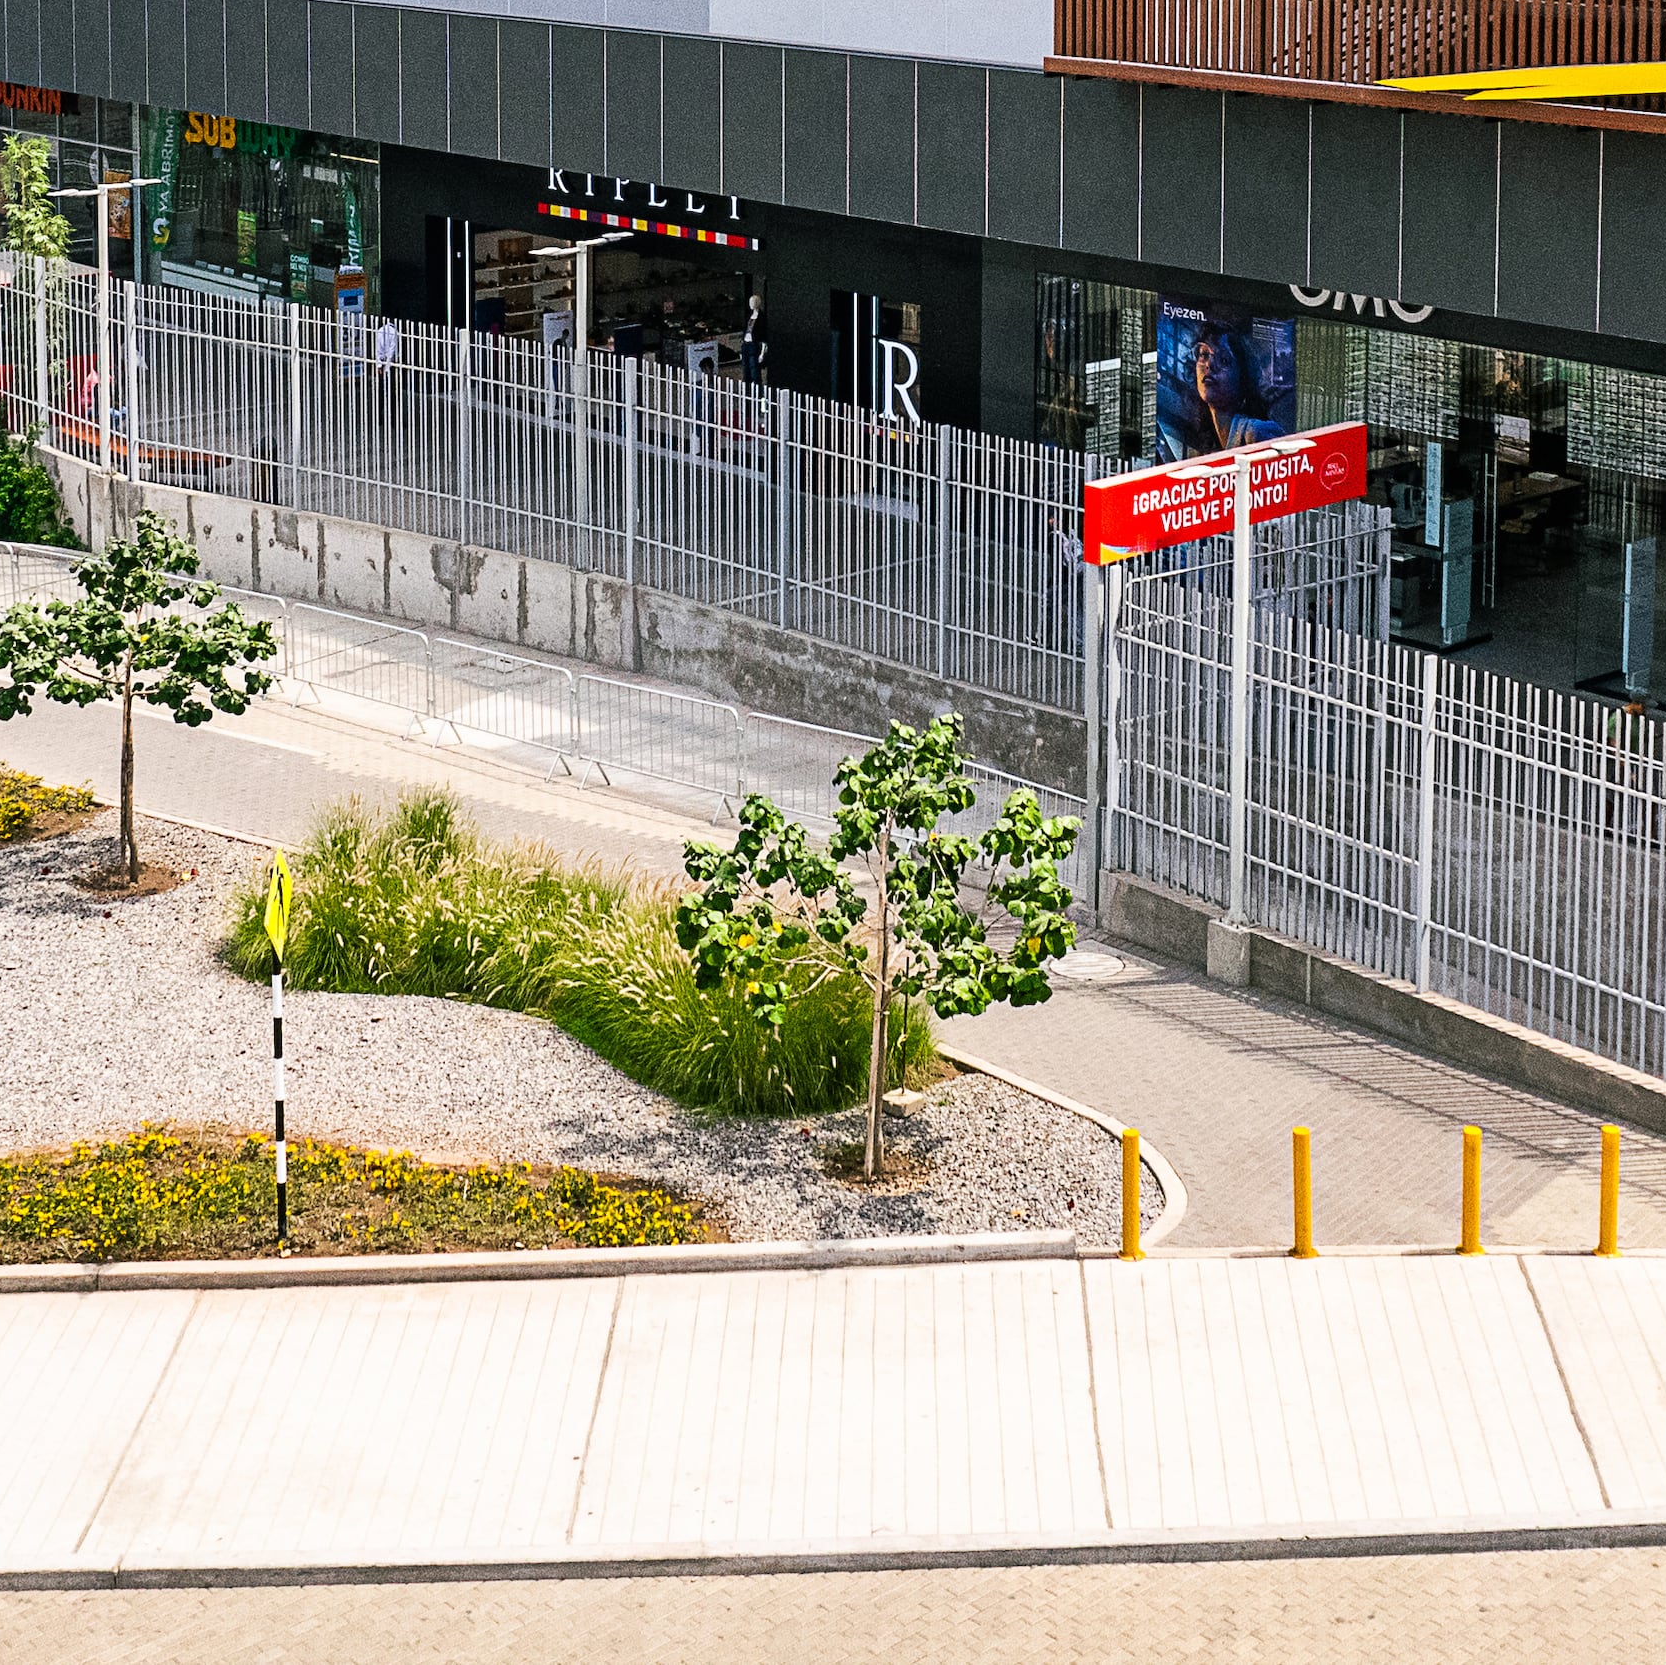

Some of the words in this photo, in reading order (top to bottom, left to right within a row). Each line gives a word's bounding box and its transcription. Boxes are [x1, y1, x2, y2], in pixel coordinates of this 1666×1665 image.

[161, 111, 176, 186] ABRIMO
[877, 338, 920, 427] R
[1133, 480, 1206, 516] ¡GRACIAS
[1265, 453, 1314, 482] VISITA,
[1161, 497, 1220, 532] VUELVE
